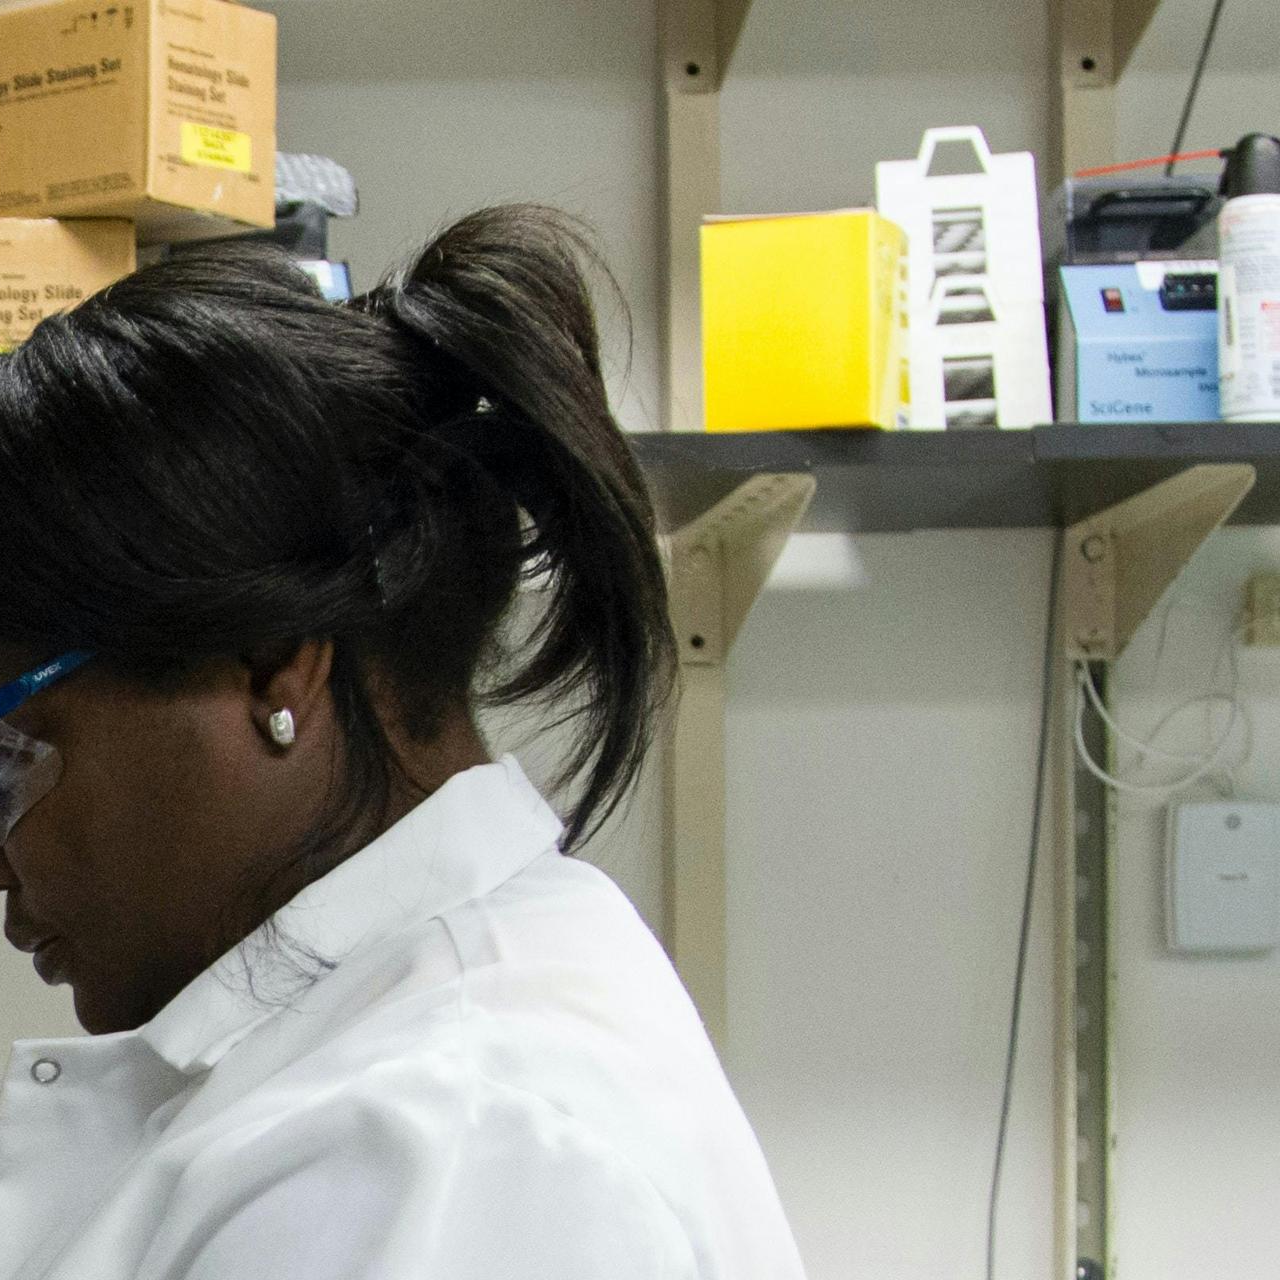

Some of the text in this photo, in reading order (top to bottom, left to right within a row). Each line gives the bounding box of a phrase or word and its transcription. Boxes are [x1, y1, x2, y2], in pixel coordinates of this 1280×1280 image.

[14, 73, 42, 90] Slide
[46, 63, 97, 84] Staining
[100, 57, 122, 74] Set
[44, 284, 83, 300] Slide
[18, 306, 44, 321] Set
[1091, 402, 1153, 415] SciGene
